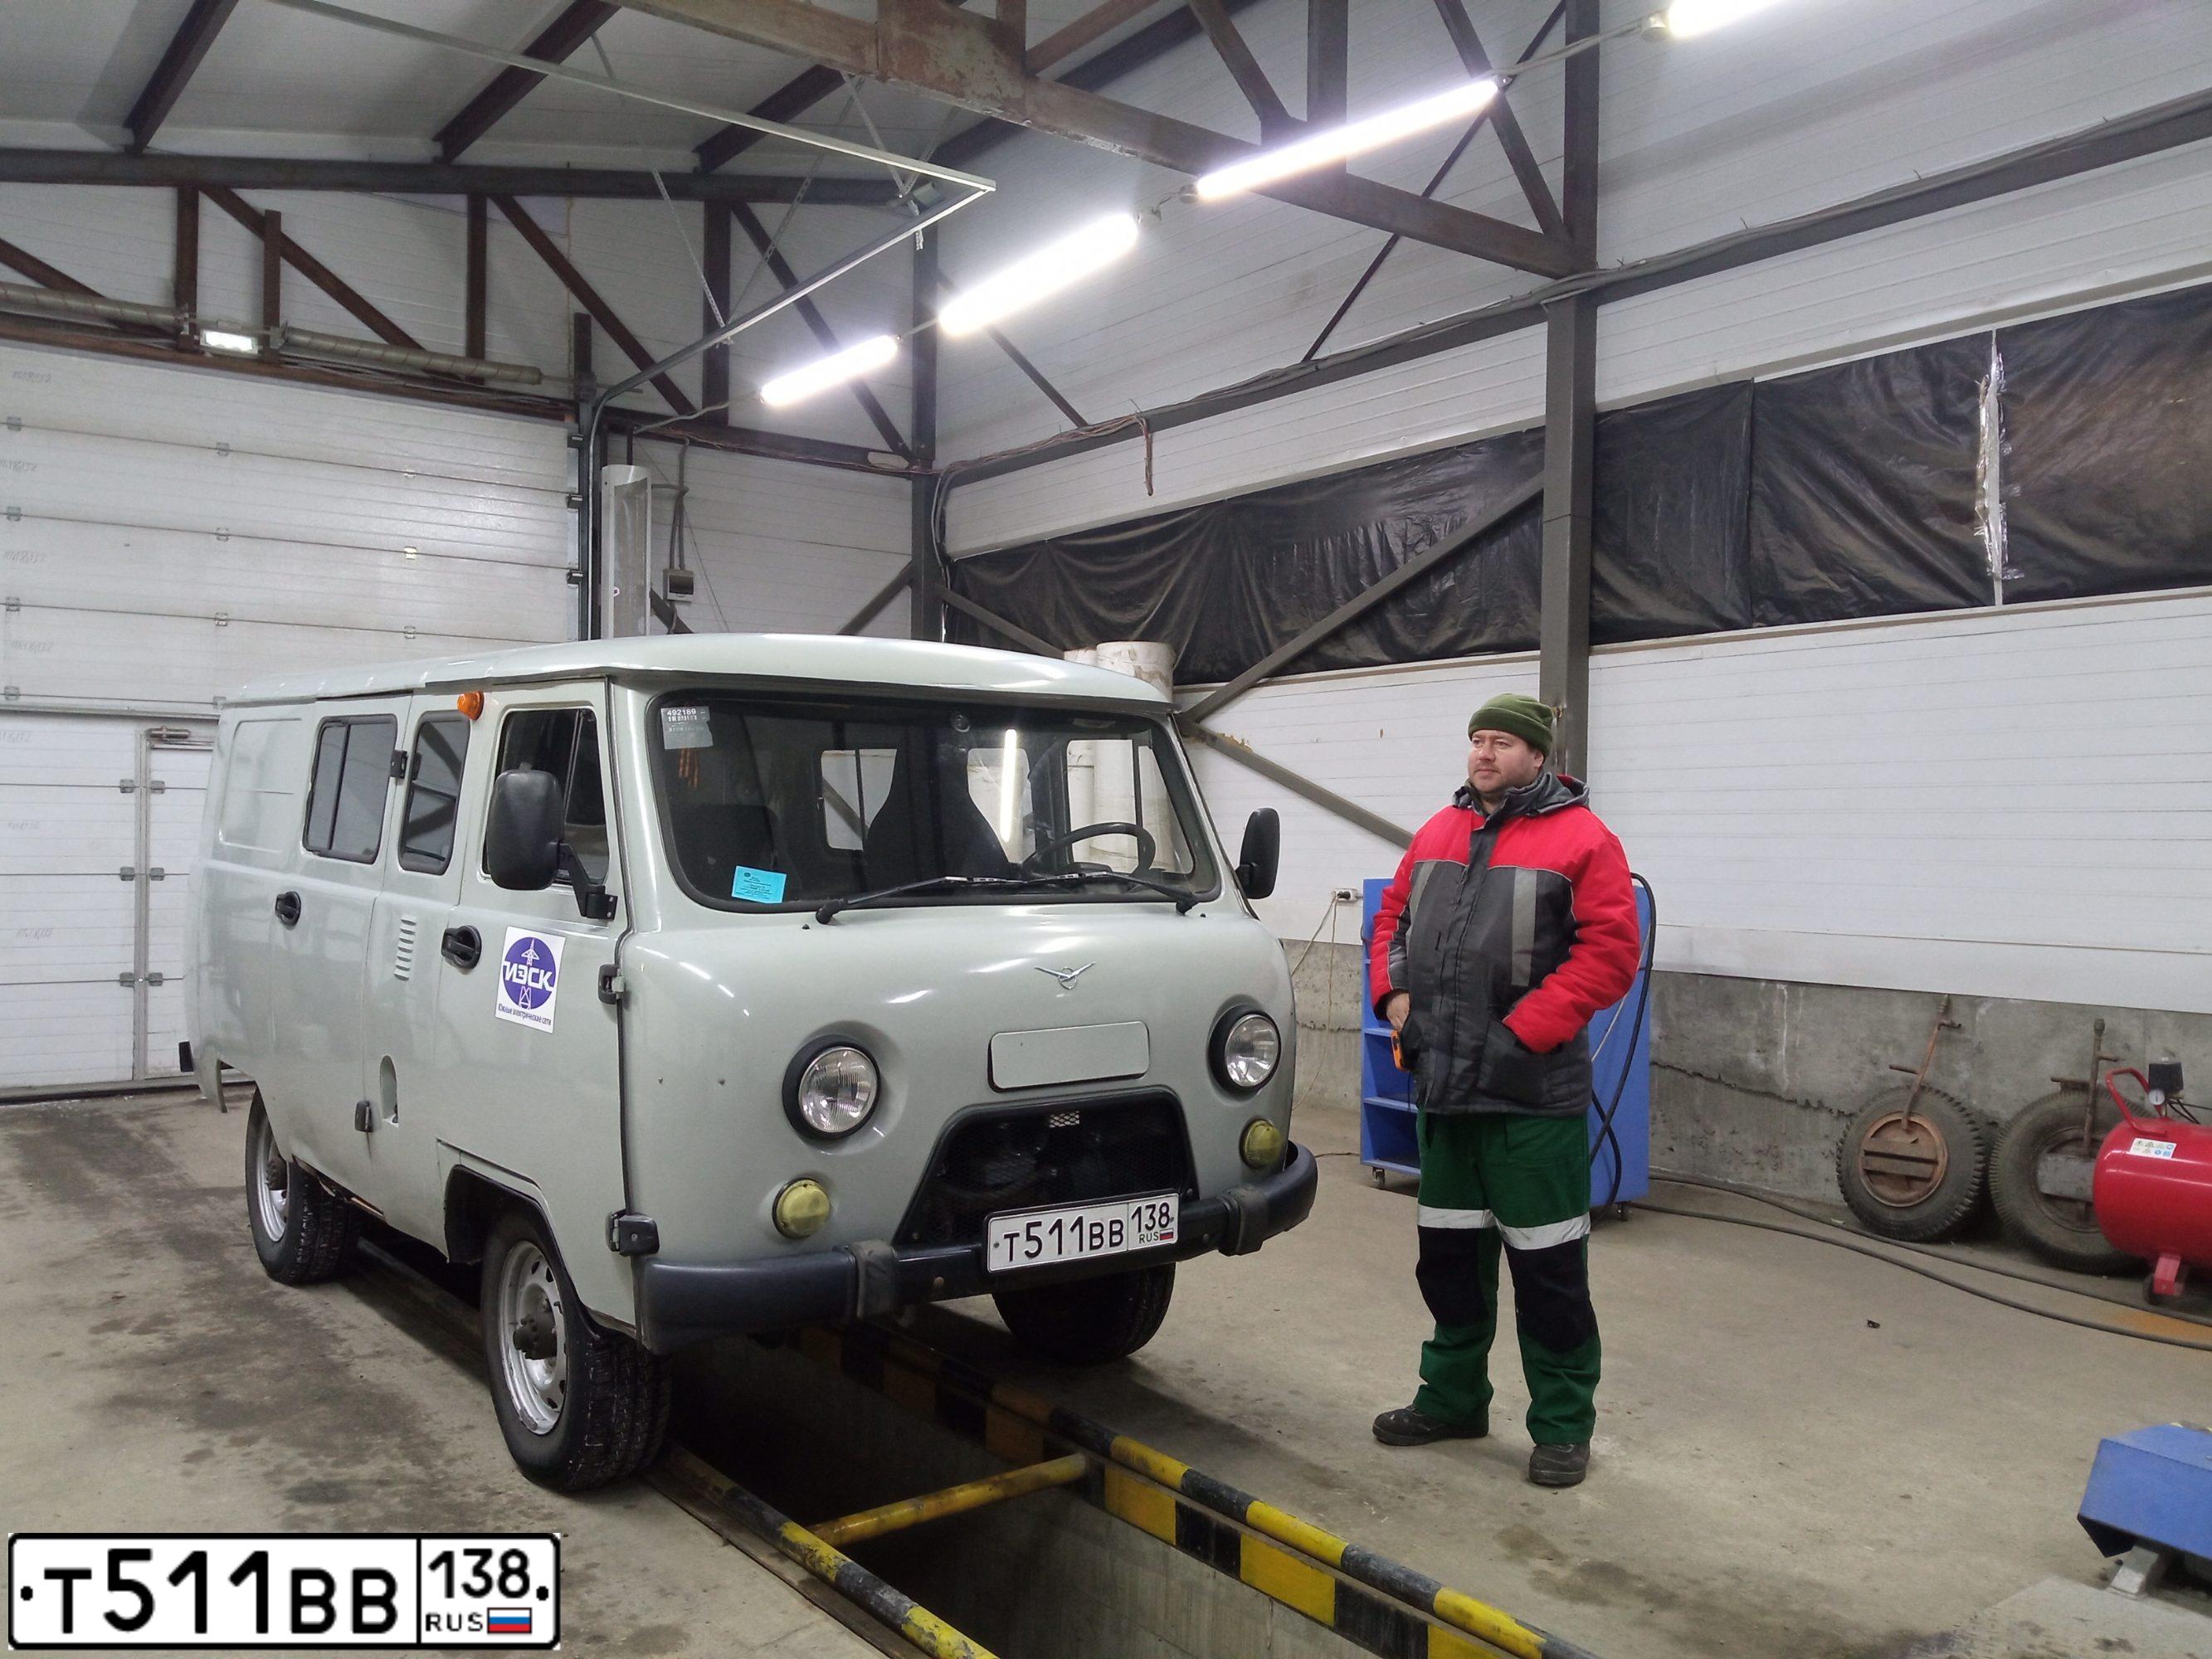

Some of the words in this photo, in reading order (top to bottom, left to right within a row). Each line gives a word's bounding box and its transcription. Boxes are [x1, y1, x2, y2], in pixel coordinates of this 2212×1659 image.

[667, 708, 697, 716] 492189
[503, 961, 555, 992] ИЭСК
[1131, 1202, 1171, 1233] 138
[1138, 1231, 1159, 1244] RUS
